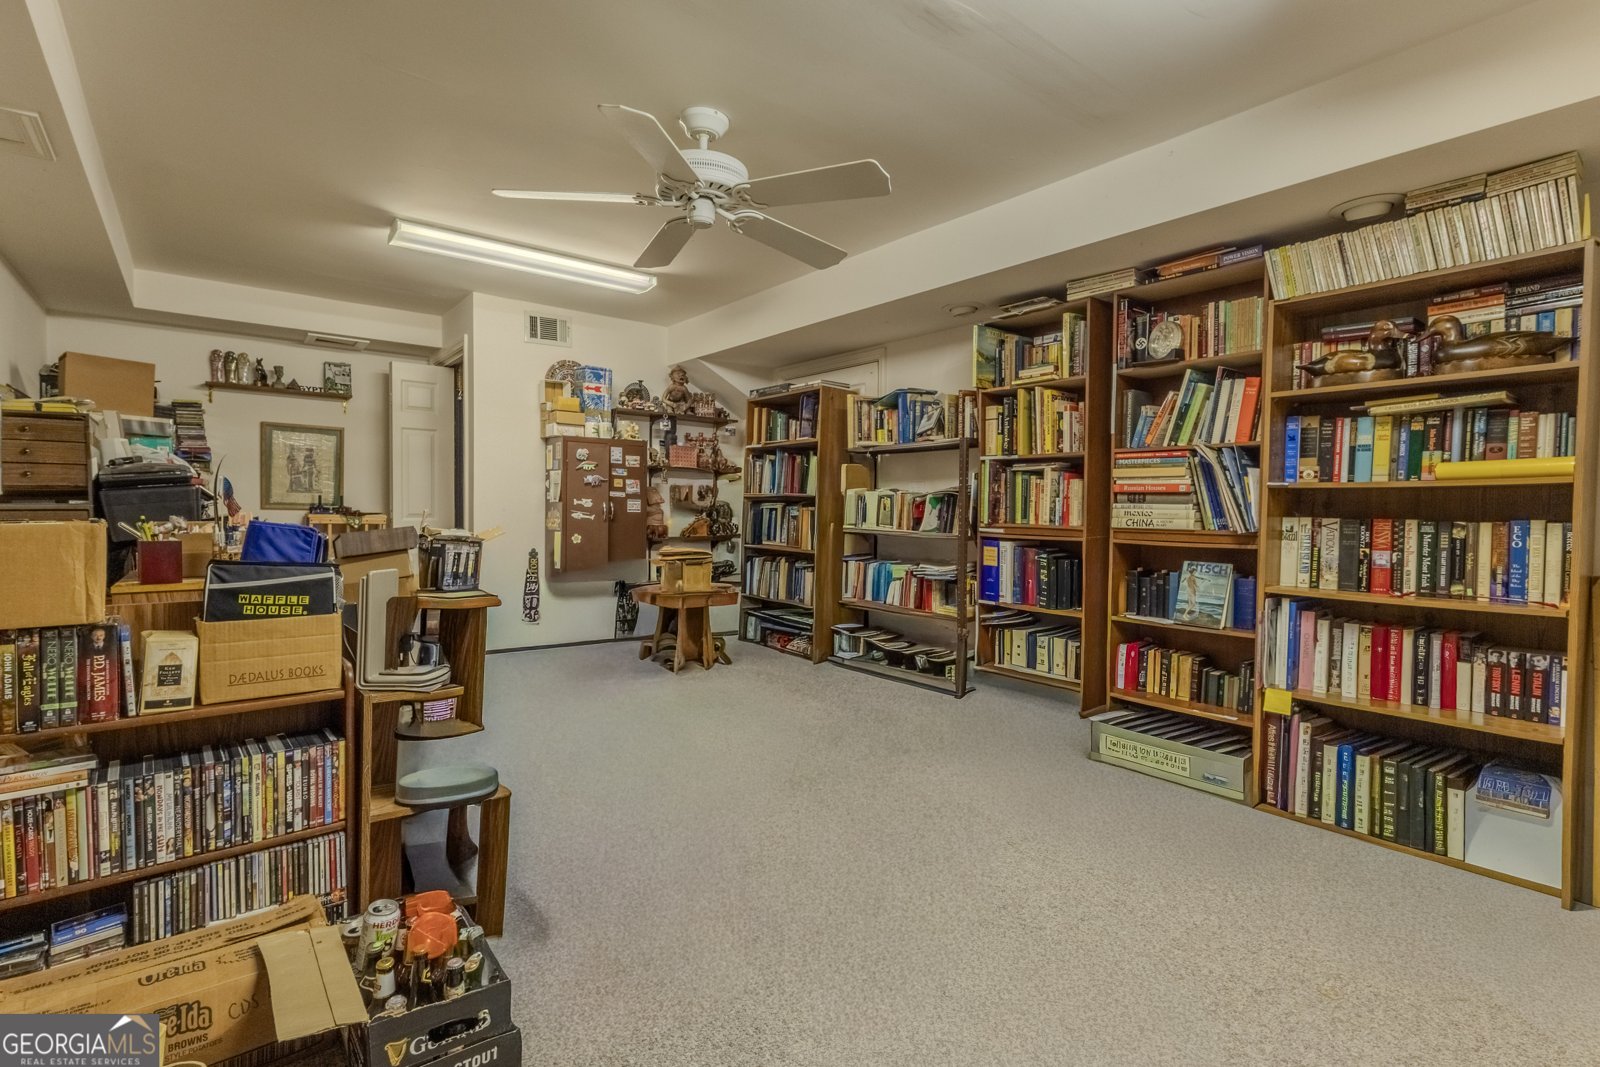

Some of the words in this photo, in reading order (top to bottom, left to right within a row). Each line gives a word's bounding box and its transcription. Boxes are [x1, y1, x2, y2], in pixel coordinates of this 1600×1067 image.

[1119, 457, 1161, 465] MASTERPIECES
[1125, 518, 1155, 528] CHINA
[1321, 521, 1338, 556] VATICAN
[1373, 522, 1391, 549] RUSSKA
[1422, 534, 1432, 556] Murder
[1511, 525, 1522, 549] ECO
[1186, 562, 1229, 576] KITSCH
[1421, 557, 1431, 573] Most
[1421, 574, 1430, 587] Irish
[238, 594, 310, 605] WAFFLE
[3, 653, 13, 672] JOHN
[21, 654, 36, 672] Fall
[47, 640, 57, 665] NERO
[64, 640, 74, 665] NERO
[93, 654, 105, 671] P.D.
[46, 668, 58, 700] WOLFE
[64, 667, 74, 698] WOLFE
[228, 669, 286, 686] DÆDALUS
[288, 664, 326, 679] BOOKS
[1491, 667, 1501, 692] TROTSKY
[1511, 669, 1520, 694] LENIN
[1532, 672, 1542, 696] STALIN
[3, 673, 14, 700] ADAMS
[20, 677, 37, 706] Eagles
[92, 672, 105, 702] JAMES
[1267, 723, 1277, 742] Atlas
[156, 785, 164, 816] MONDAYS
[156, 834, 165, 853] SUN
[6, 864, 14, 887] ODYSSEY
[84, 957, 119, 970] DROP
[125, 949, 148, 959] NOT
[57, 973, 80, 982] ALL
[165, 1000, 213, 1038] re-Ida
[167, 1032, 209, 1053] BROWNS
